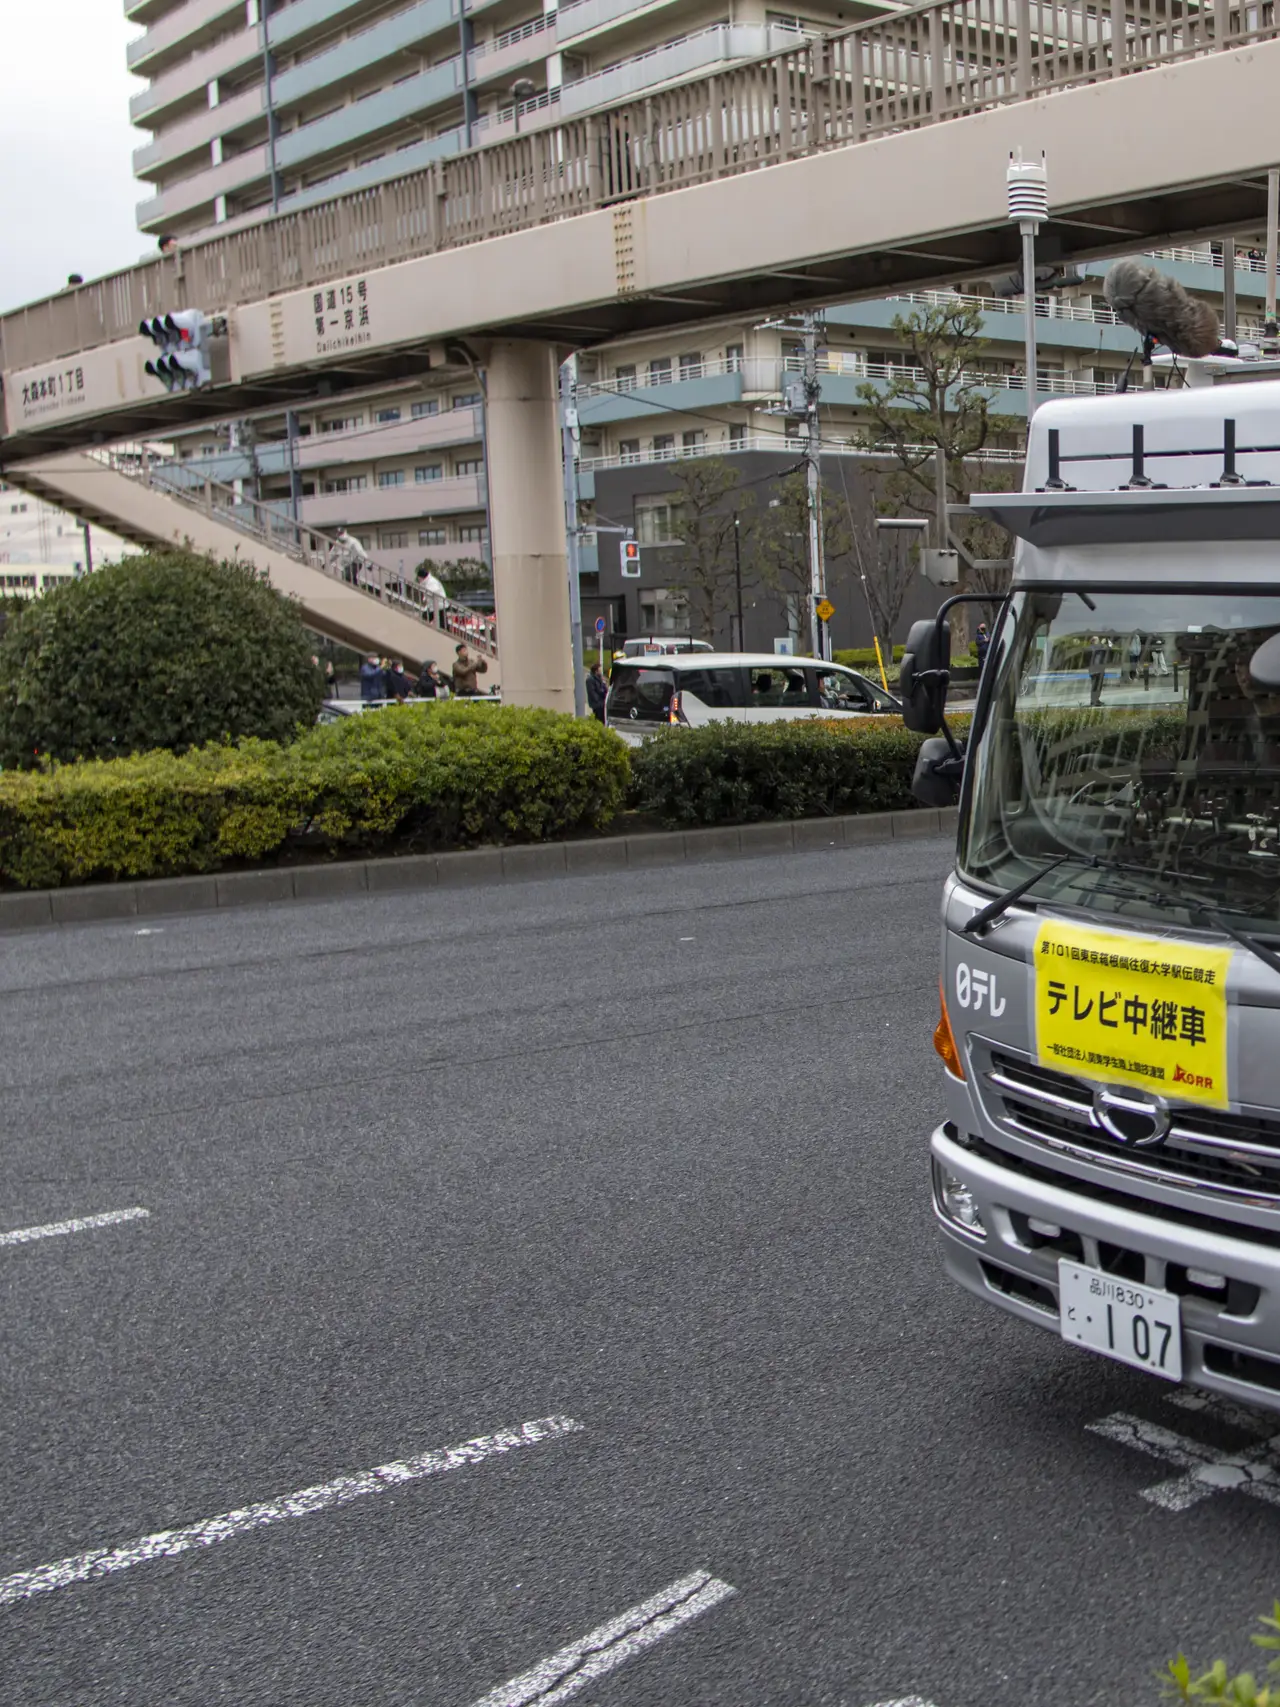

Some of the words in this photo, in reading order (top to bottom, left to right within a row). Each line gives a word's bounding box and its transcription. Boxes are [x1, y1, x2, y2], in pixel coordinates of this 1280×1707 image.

[313, 279, 367, 314] 国道15号
[315, 304, 370, 337] 第一京浜
[1041, 940, 1216, 985] 第101回東京箱根間往復大学駅伝競走
[955, 962, 1007, 1018] 日テレ
[1047, 980, 1207, 1047] テレビ中継車
[1090, 1277, 1145, 1309] 品川830
[1067, 1306, 1076, 1321] と
